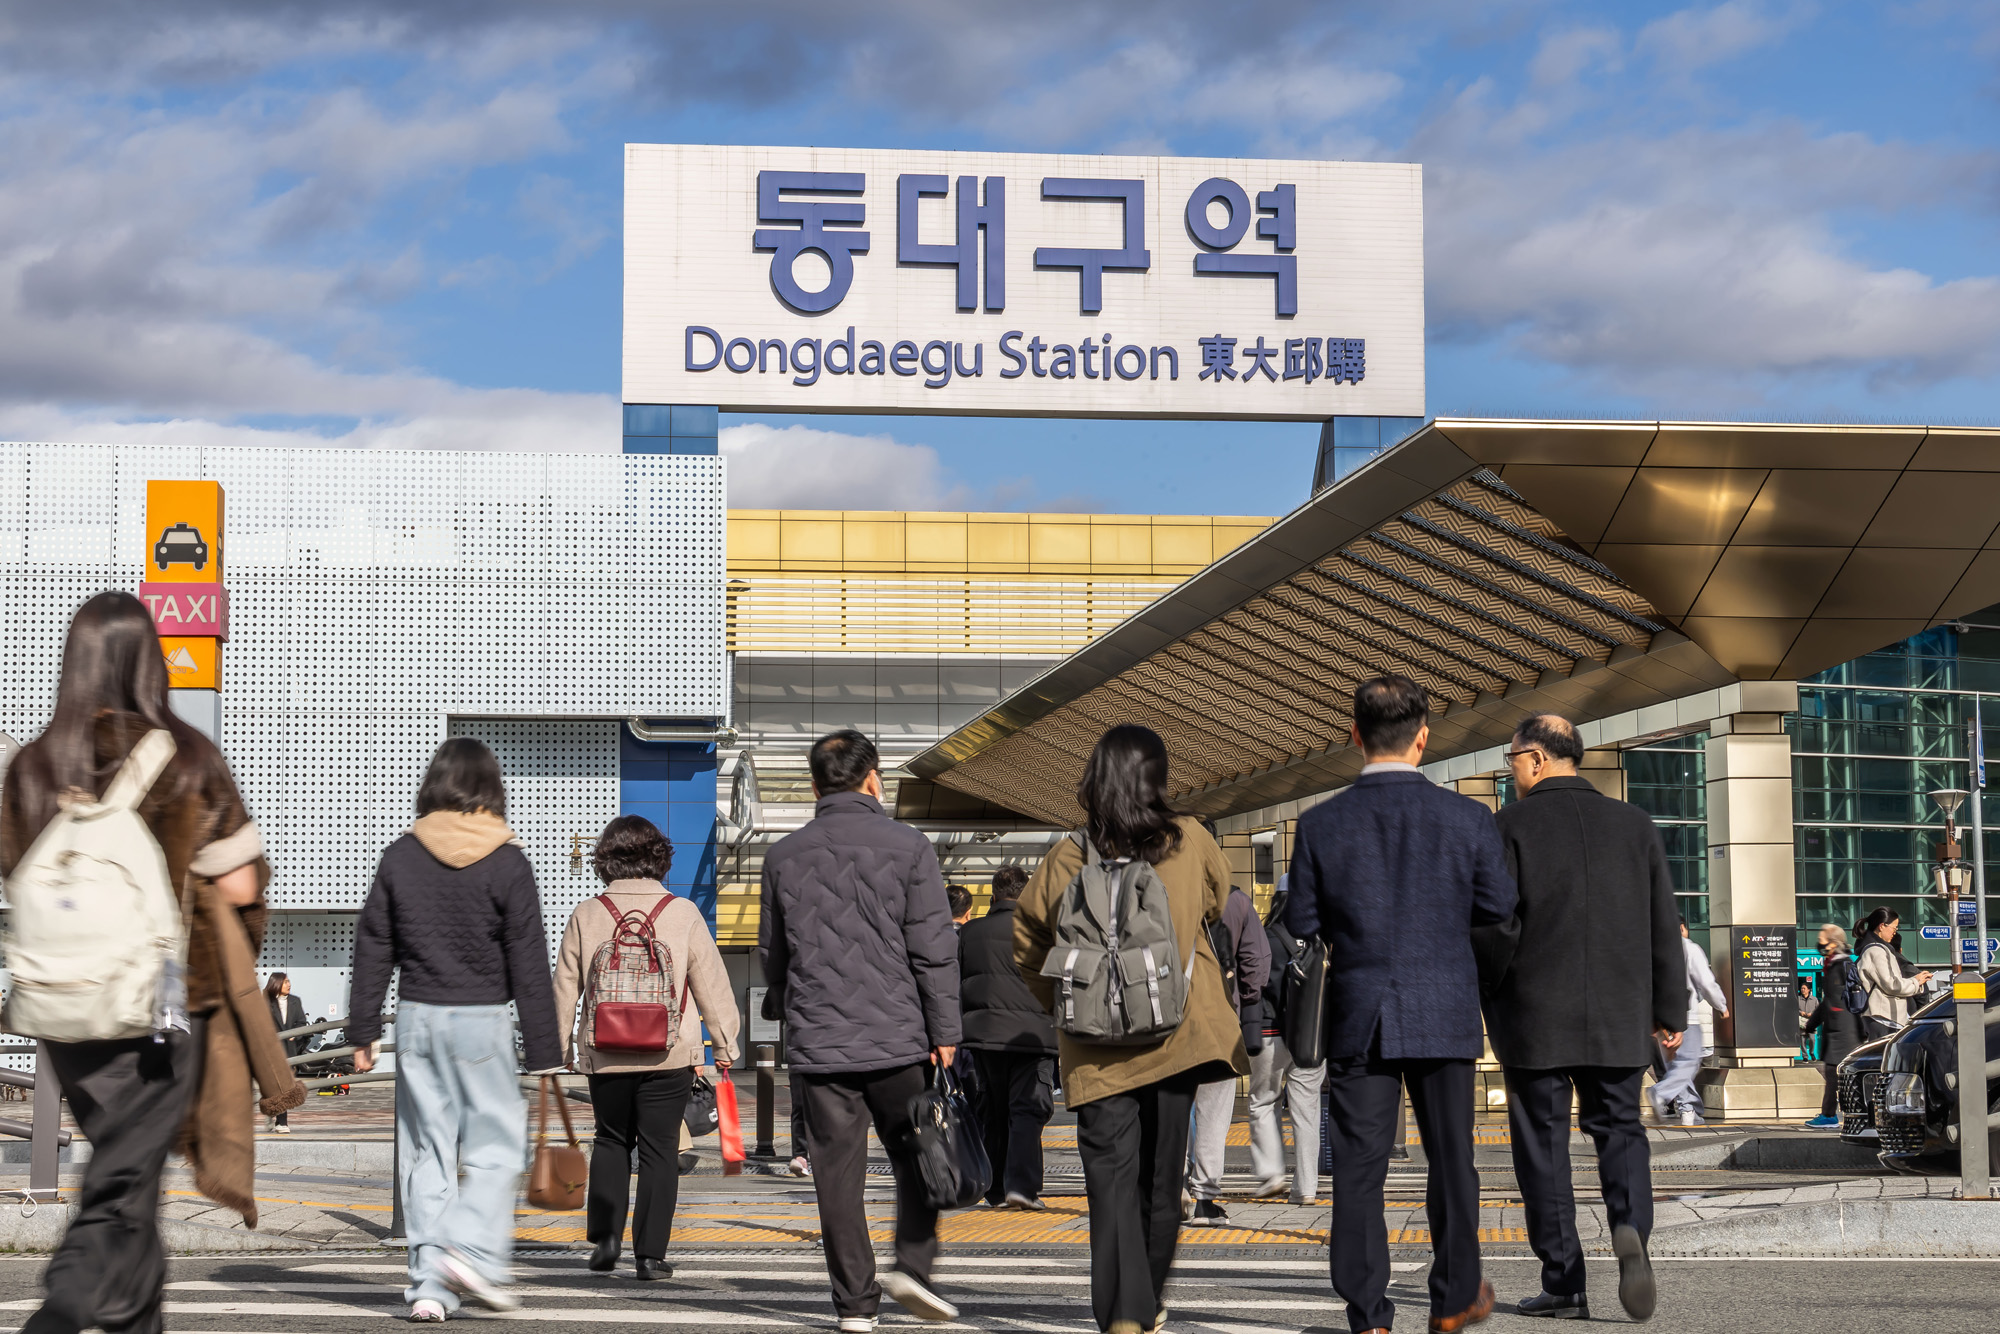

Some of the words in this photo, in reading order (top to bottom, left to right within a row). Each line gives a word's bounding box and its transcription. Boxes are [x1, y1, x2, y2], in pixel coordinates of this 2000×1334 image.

[753, 168, 1298, 317] 동대구역
[685, 325, 983, 387] Dongdaegu
[998, 331, 1179, 380] Station
[1199, 333, 1367, 385] 東大邱驛
[143, 594, 216, 623] TAXI
